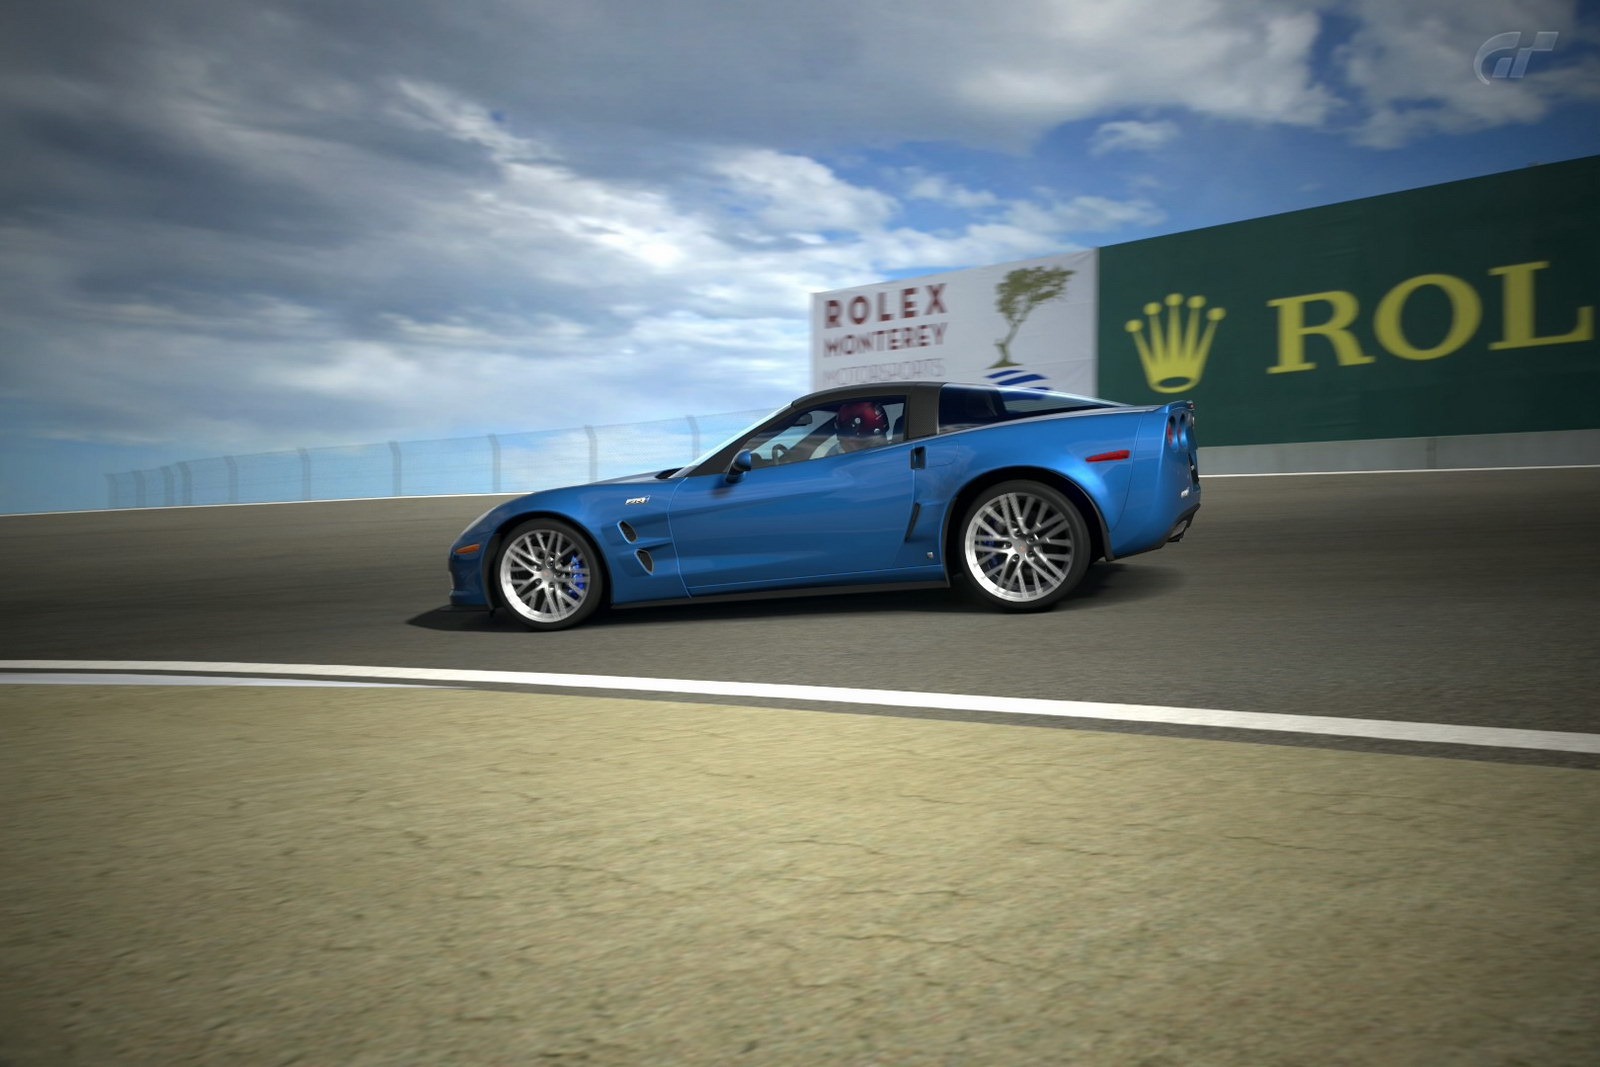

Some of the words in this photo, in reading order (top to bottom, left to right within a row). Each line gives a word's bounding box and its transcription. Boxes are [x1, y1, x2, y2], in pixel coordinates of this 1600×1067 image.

[824, 283, 948, 329] ROLEX
[1266, 260, 1595, 374] ROL
[823, 322, 949, 356] MONTEREY
